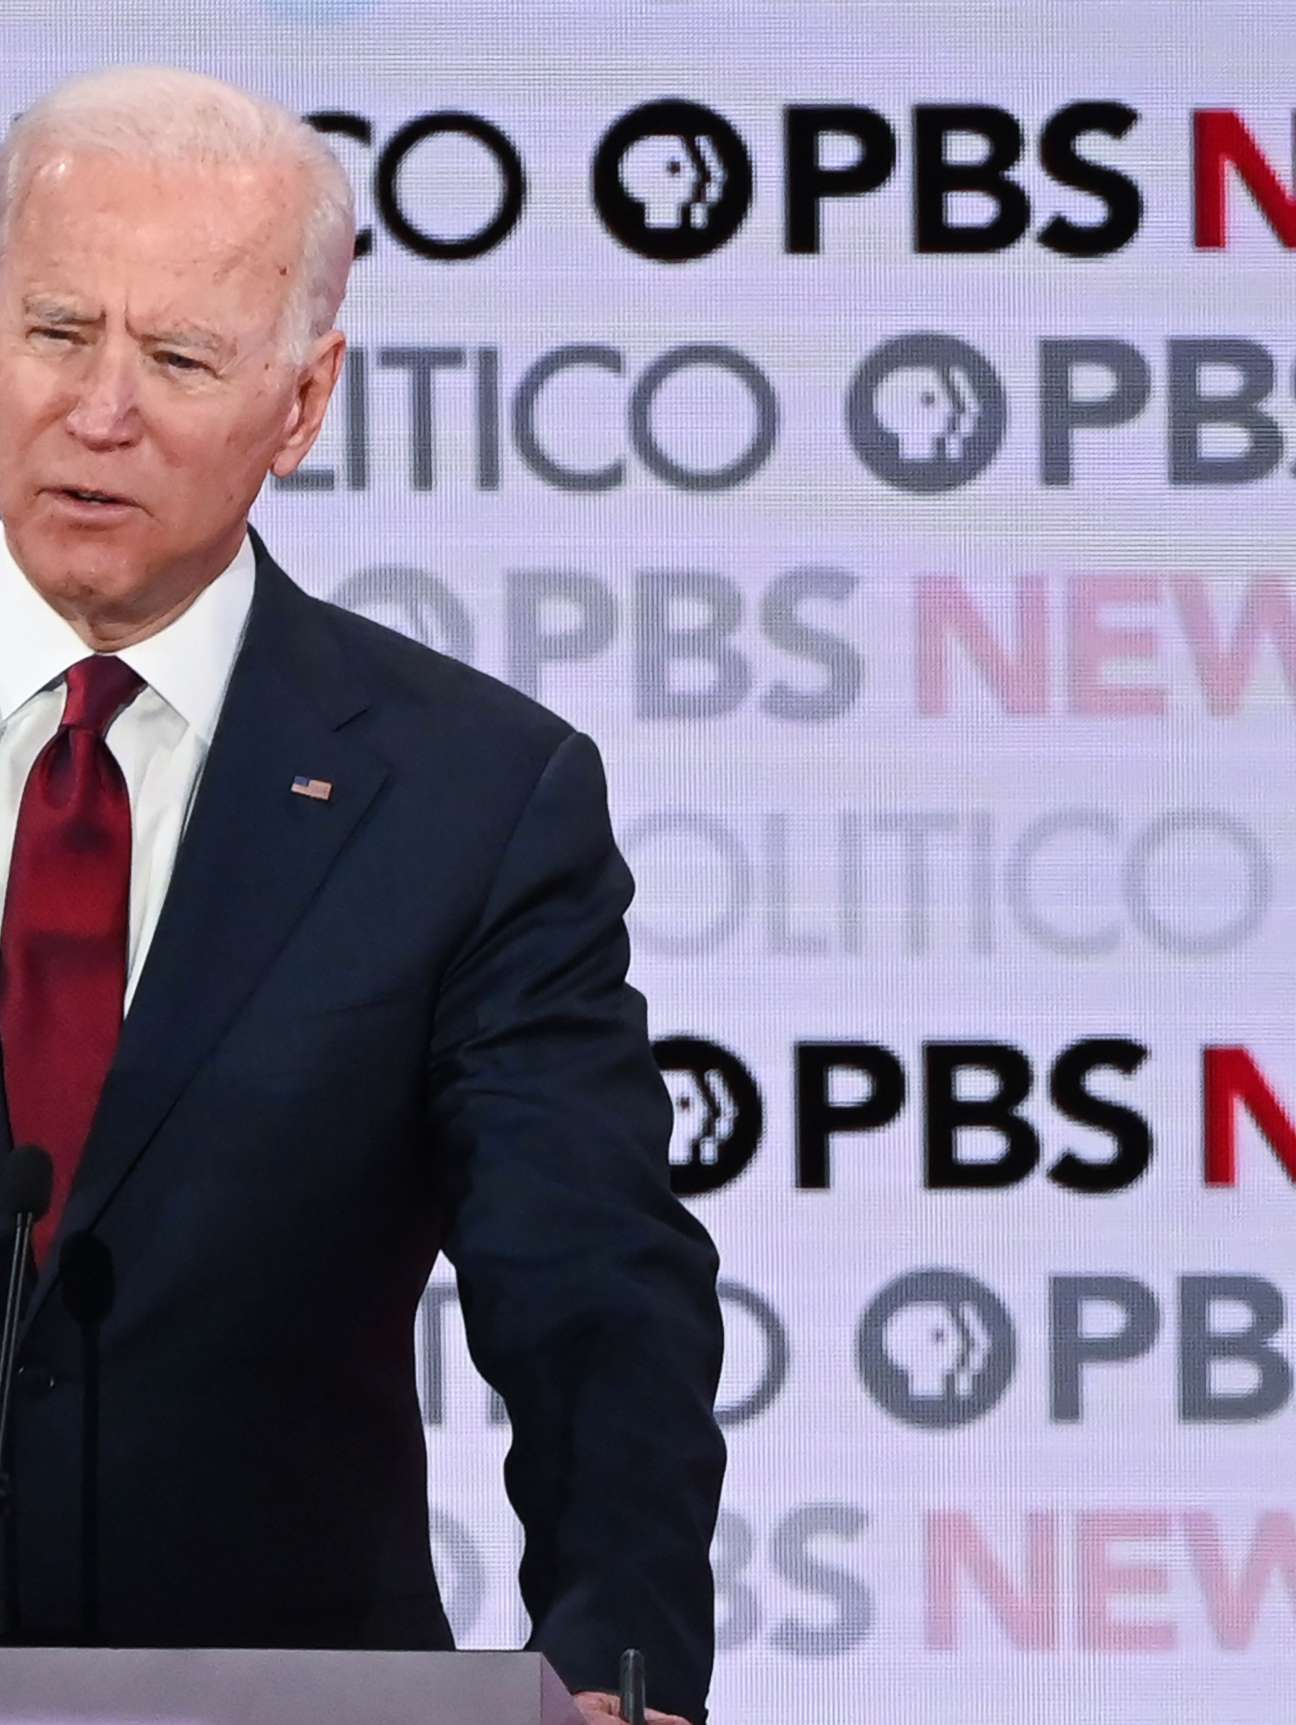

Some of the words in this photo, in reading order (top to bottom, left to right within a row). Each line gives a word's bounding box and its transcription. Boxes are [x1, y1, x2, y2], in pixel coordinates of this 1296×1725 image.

[784, 100, 1145, 259] PBS
[1038, 336, 1296, 488] PB
[505, 566, 864, 722] PBS
[794, 1037, 1154, 1194] PBS
